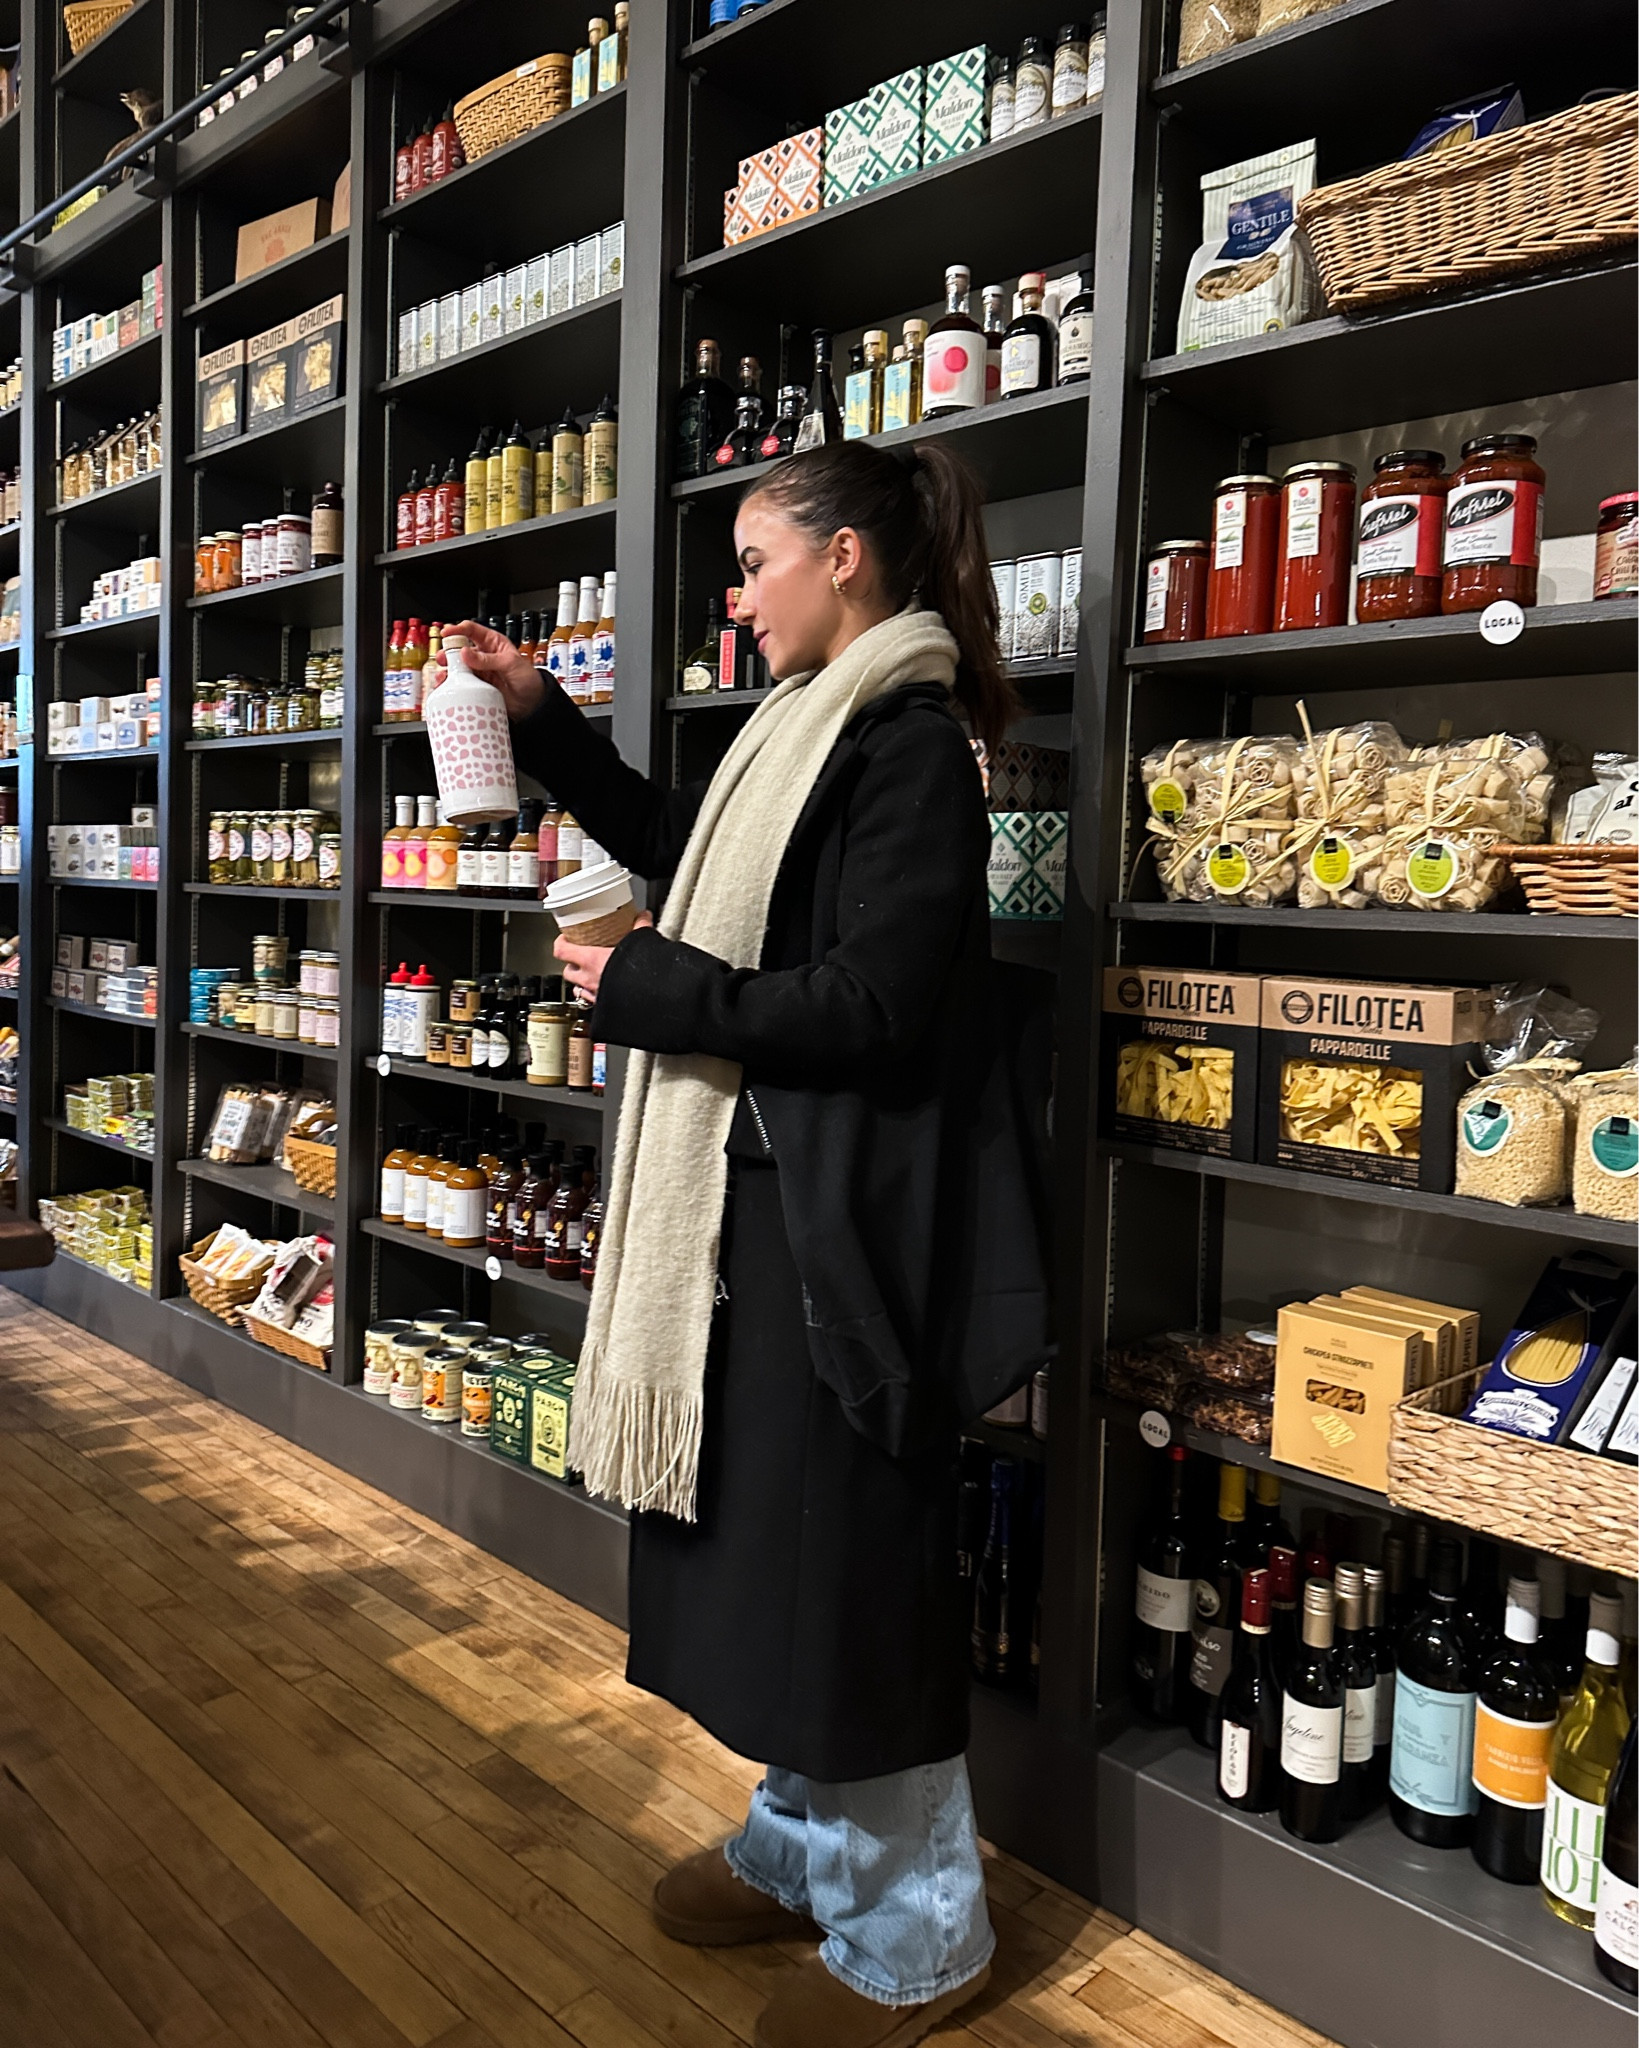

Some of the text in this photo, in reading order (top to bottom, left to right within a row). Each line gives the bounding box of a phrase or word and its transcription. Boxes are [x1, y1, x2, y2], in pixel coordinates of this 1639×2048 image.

[933, 97, 975, 121] Maldon
[875, 118, 911, 143] Maldon
[831, 144, 867, 166] Maldon
[1231, 209, 1291, 235] GENTILE
[307, 301, 334, 328] FILOTEA
[260, 325, 287, 351] FILOTEA
[211, 346, 236, 371] FILOTEA
[1484, 618, 1521, 630] LOCAL
[1147, 979, 1236, 1015] FILOTEA
[1317, 992, 1424, 1032] FILOTEA
[1141, 1020, 1208, 1041] PAPPARDELLE
[1309, 1037, 1393, 1061] PAPPARDELLE
[1142, 1420, 1168, 1439] LOCAL
